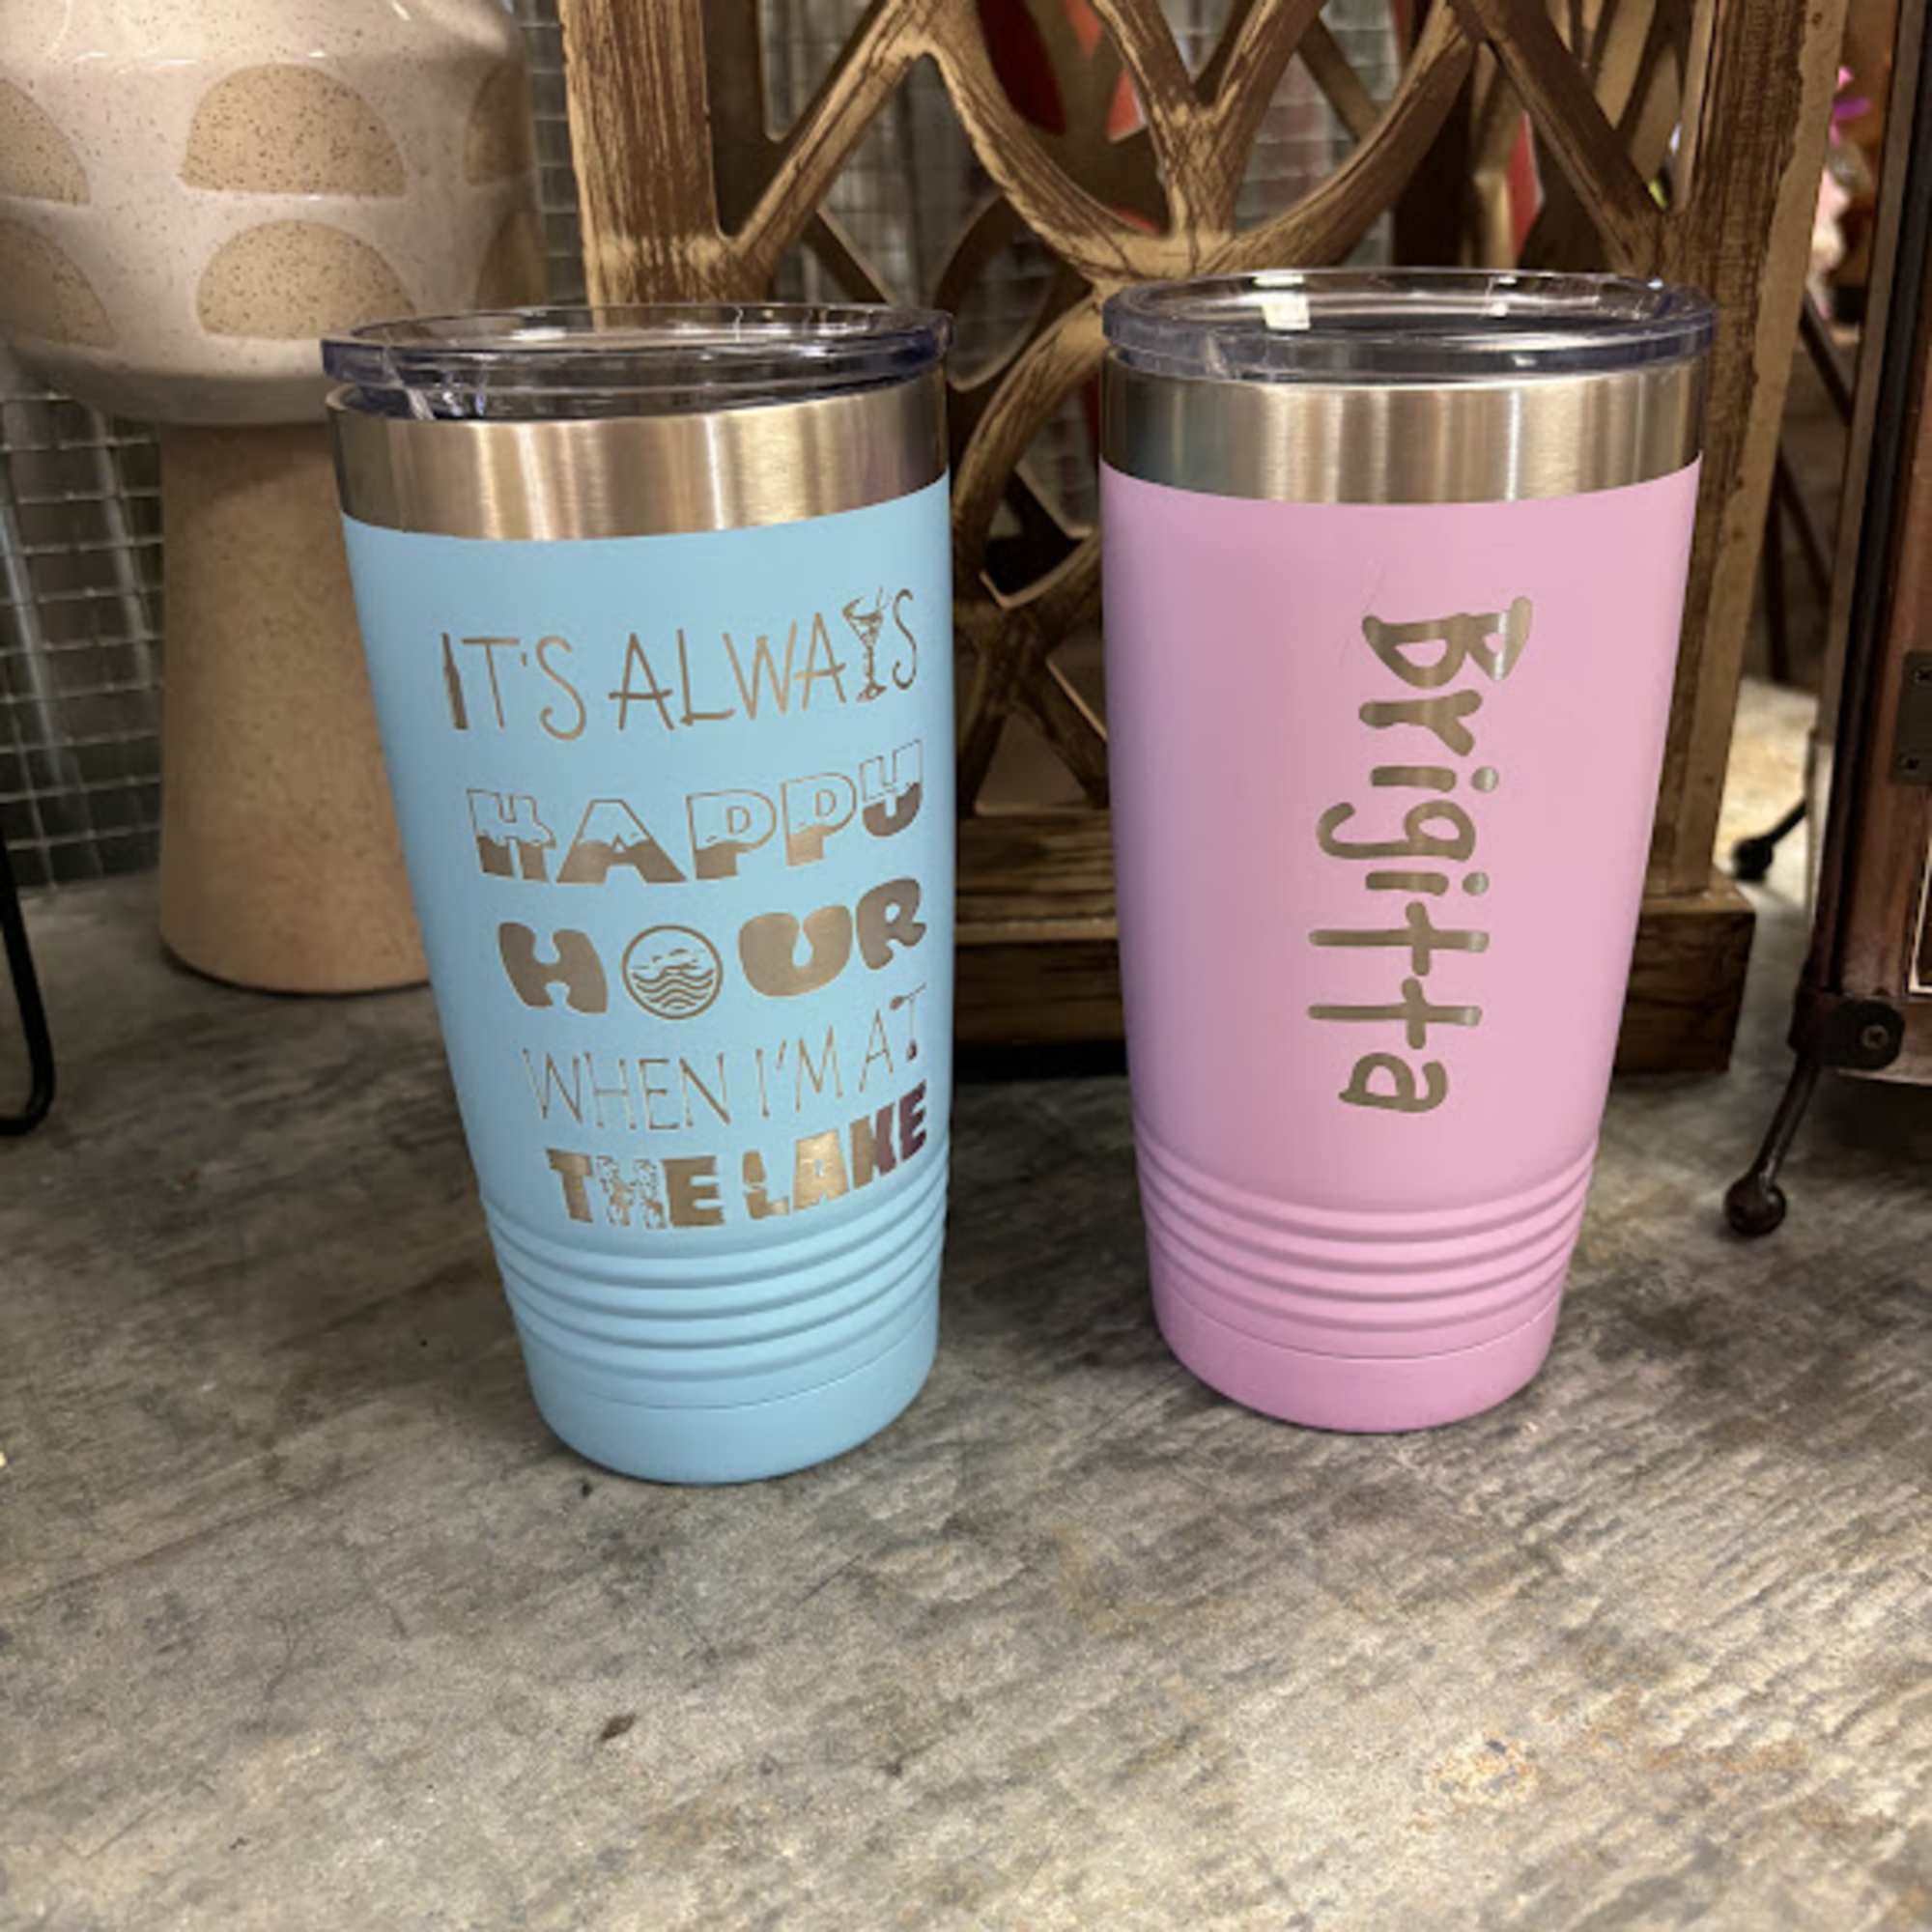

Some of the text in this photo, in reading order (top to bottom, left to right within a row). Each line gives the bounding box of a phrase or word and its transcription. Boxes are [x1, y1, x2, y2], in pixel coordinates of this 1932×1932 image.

[441, 586, 918, 741] IT'S ALWAYS
[1307, 596, 1533, 1113] Brigitta
[523, 983, 927, 1130] WHEN I'M AT
[546, 1080, 927, 1230] THE LAKE
